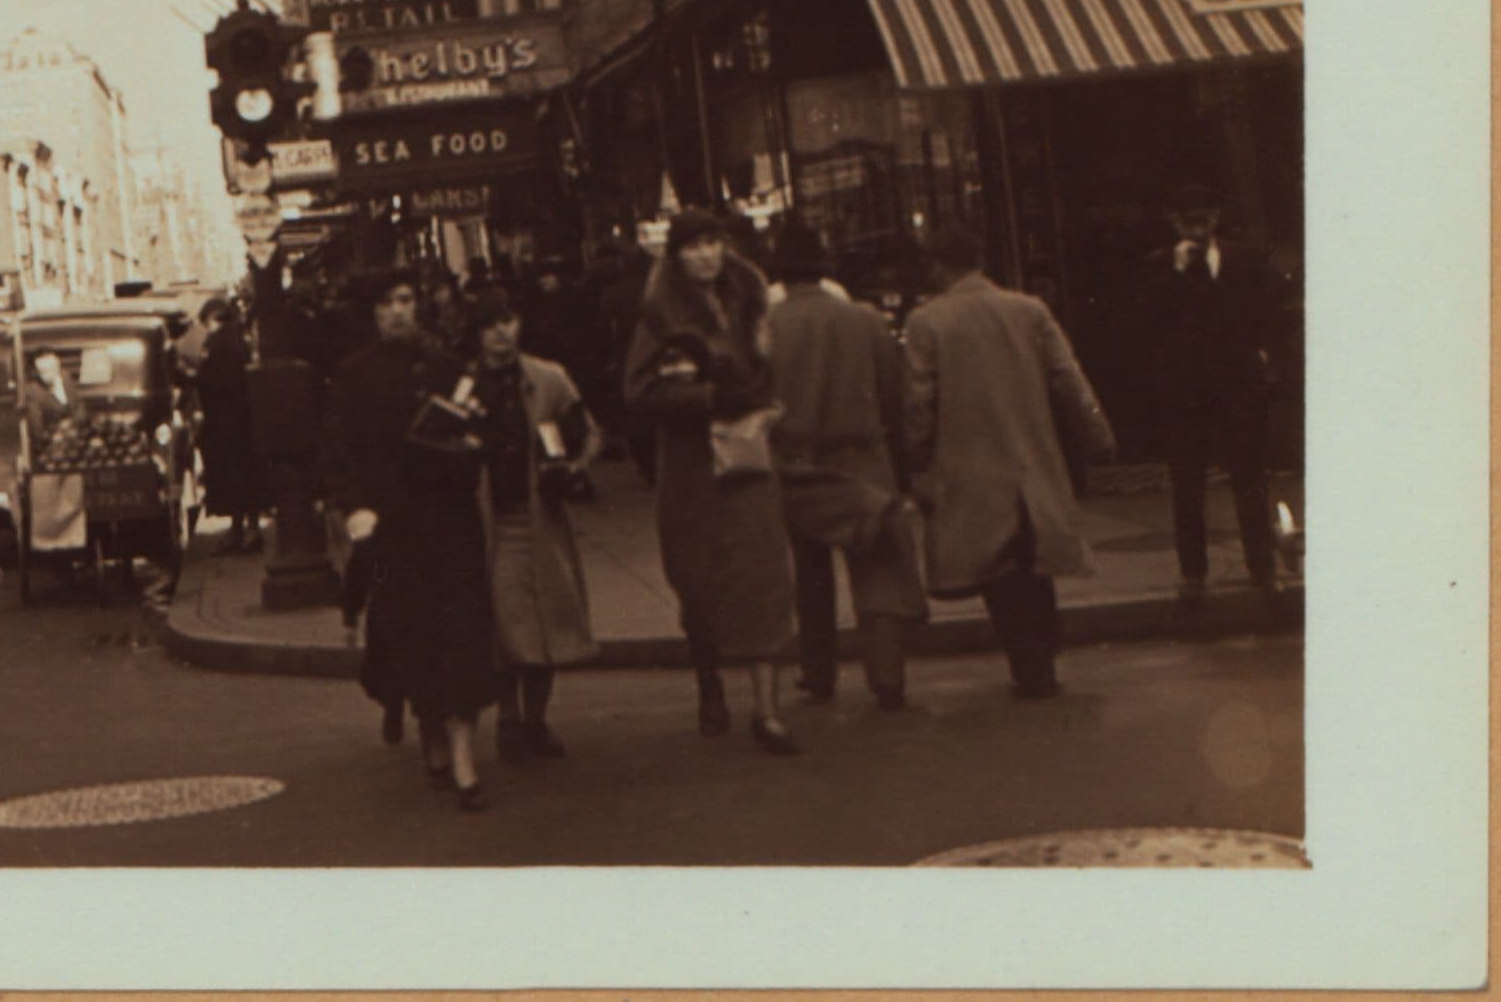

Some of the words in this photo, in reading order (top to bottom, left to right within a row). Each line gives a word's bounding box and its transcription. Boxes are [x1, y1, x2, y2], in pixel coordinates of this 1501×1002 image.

[376, 38, 538, 81] helby's
[355, 140, 411, 164] SEA
[431, 129, 507, 157] FOOD
